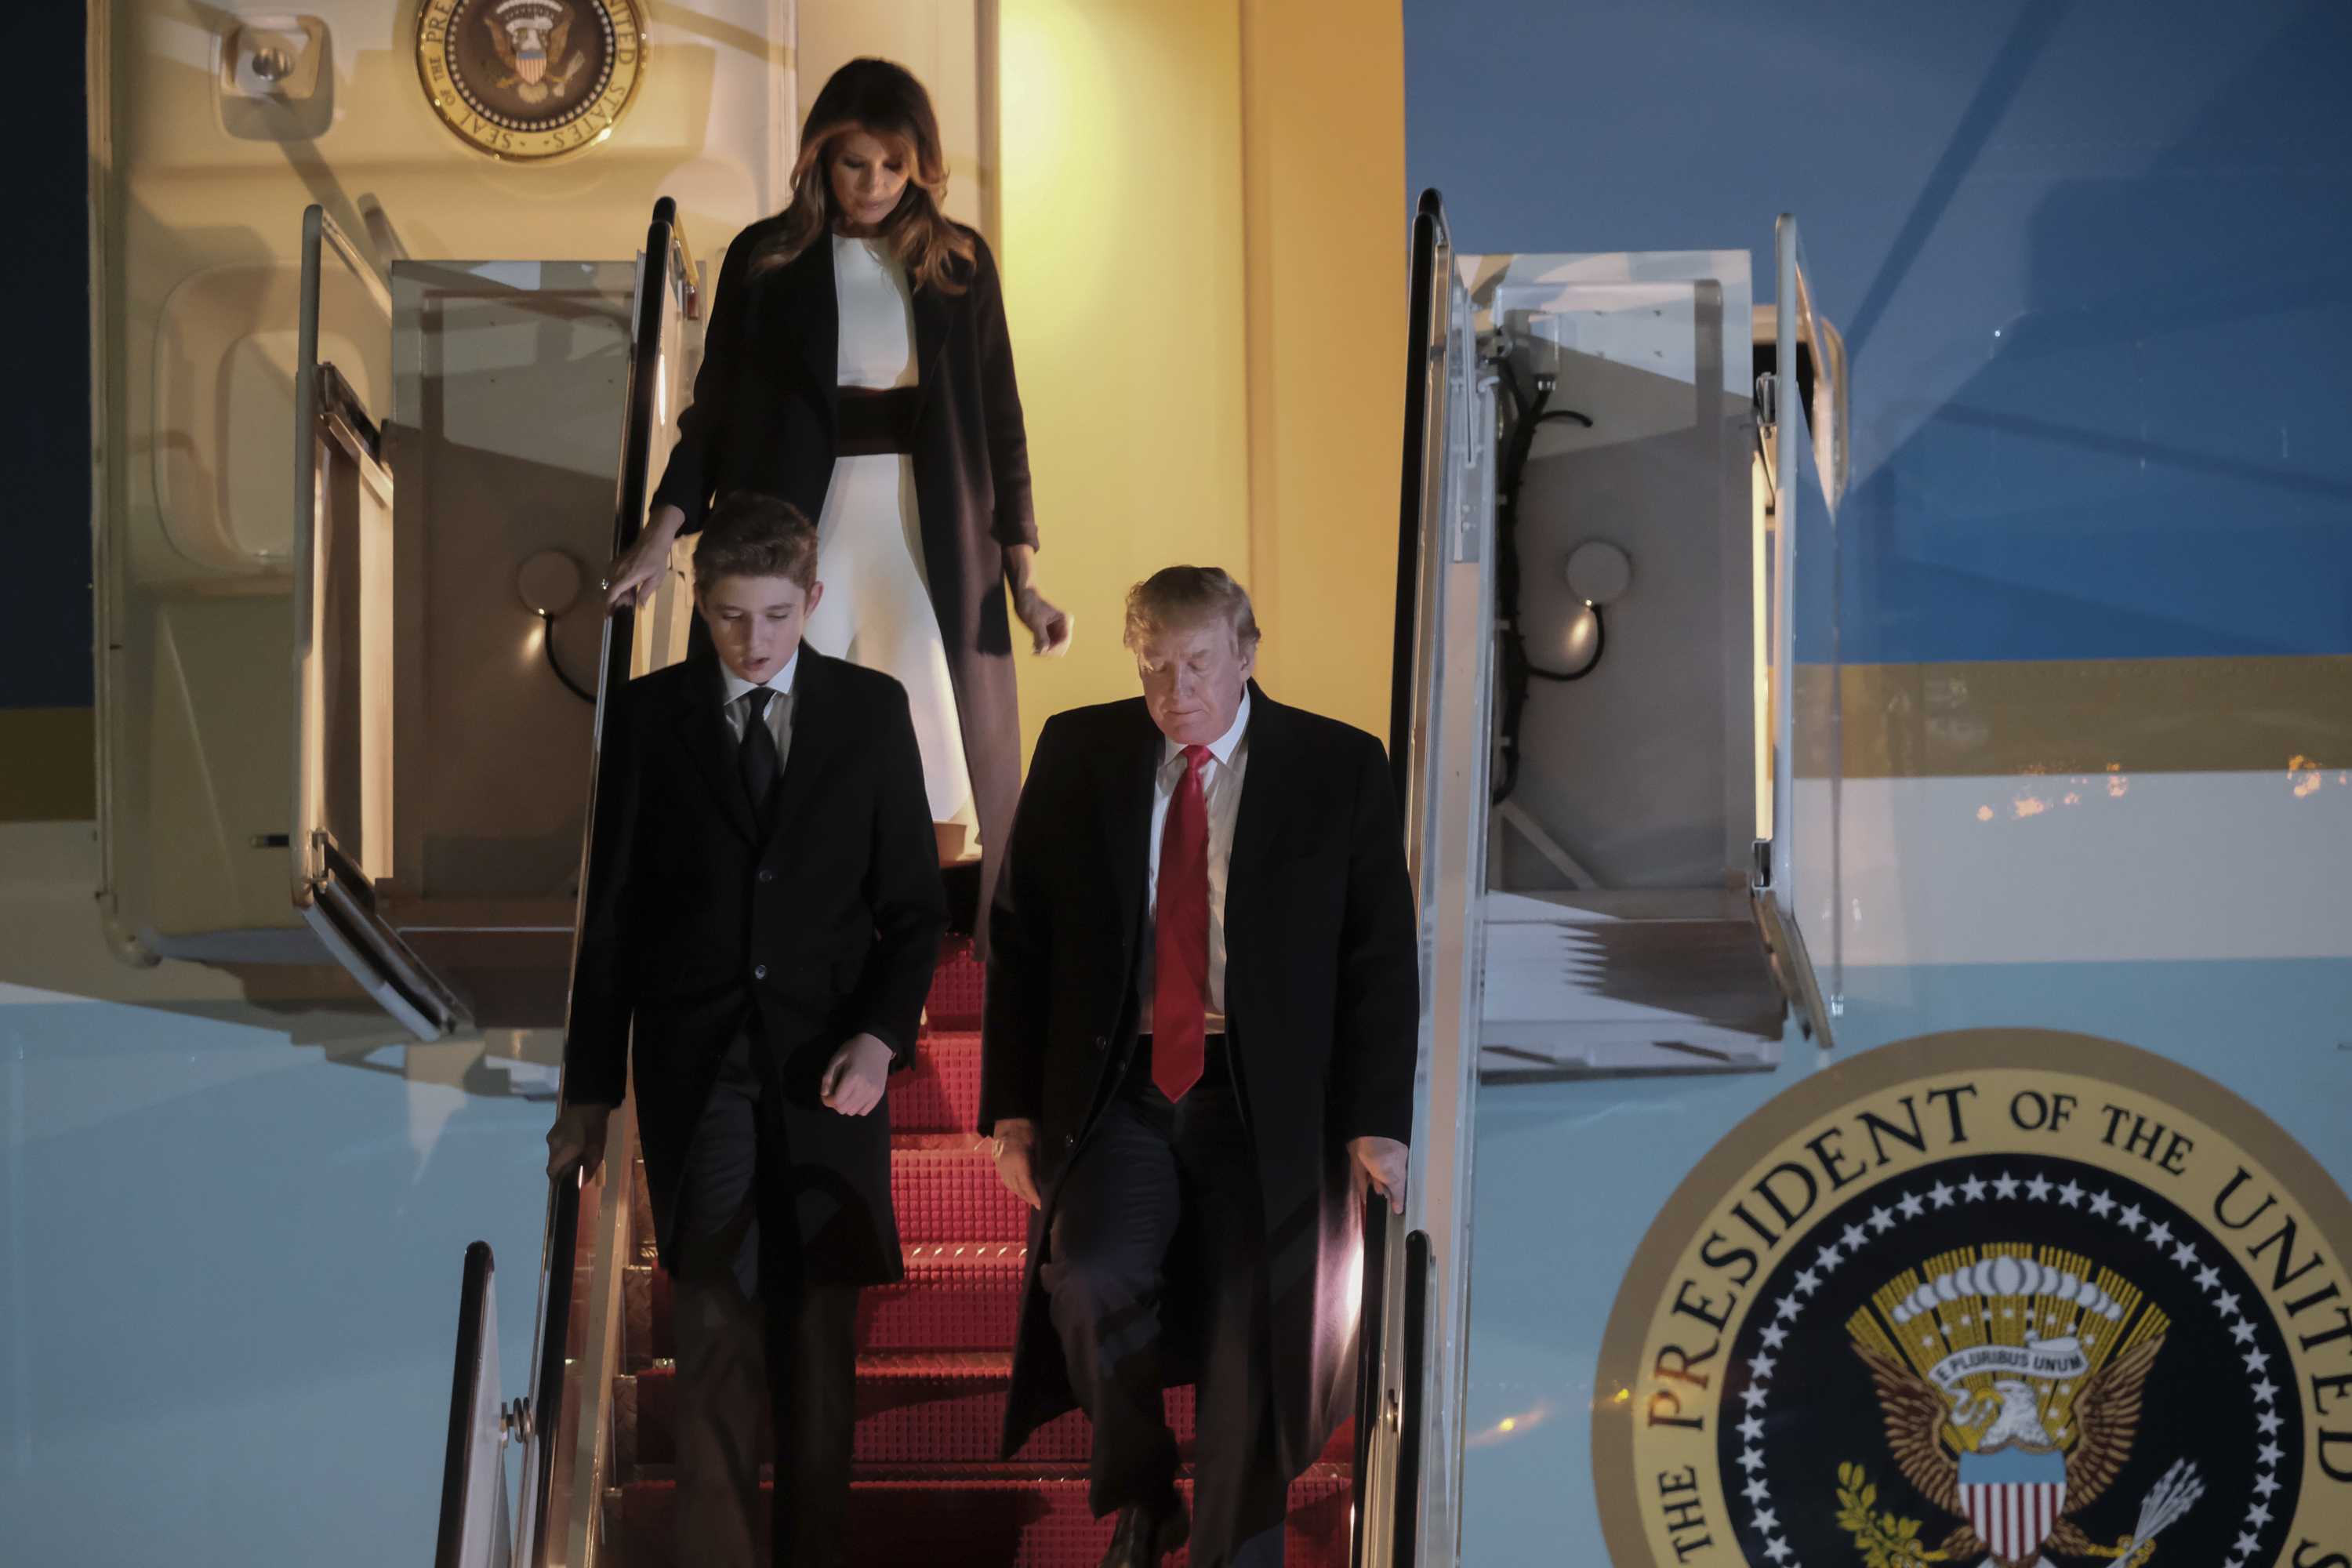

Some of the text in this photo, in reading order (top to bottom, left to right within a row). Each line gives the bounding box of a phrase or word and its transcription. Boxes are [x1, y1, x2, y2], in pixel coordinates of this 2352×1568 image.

[429, 56, 445, 83] THE
[440, 89, 456, 107] OF
[553, 82, 626, 149] STATES
[459, 108, 514, 149] SEAL
[2009, 1090, 2078, 1133] OF
[2100, 1102, 2195, 1176] THE
[1647, 1083, 1978, 1432] PRESIDENT
[2212, 1164, 2352, 1483] UNITED
[1935, 1367, 1950, 1381] E
[2033, 1356, 2084, 1372] UNUM
[1657, 1465, 1714, 1565] THE
